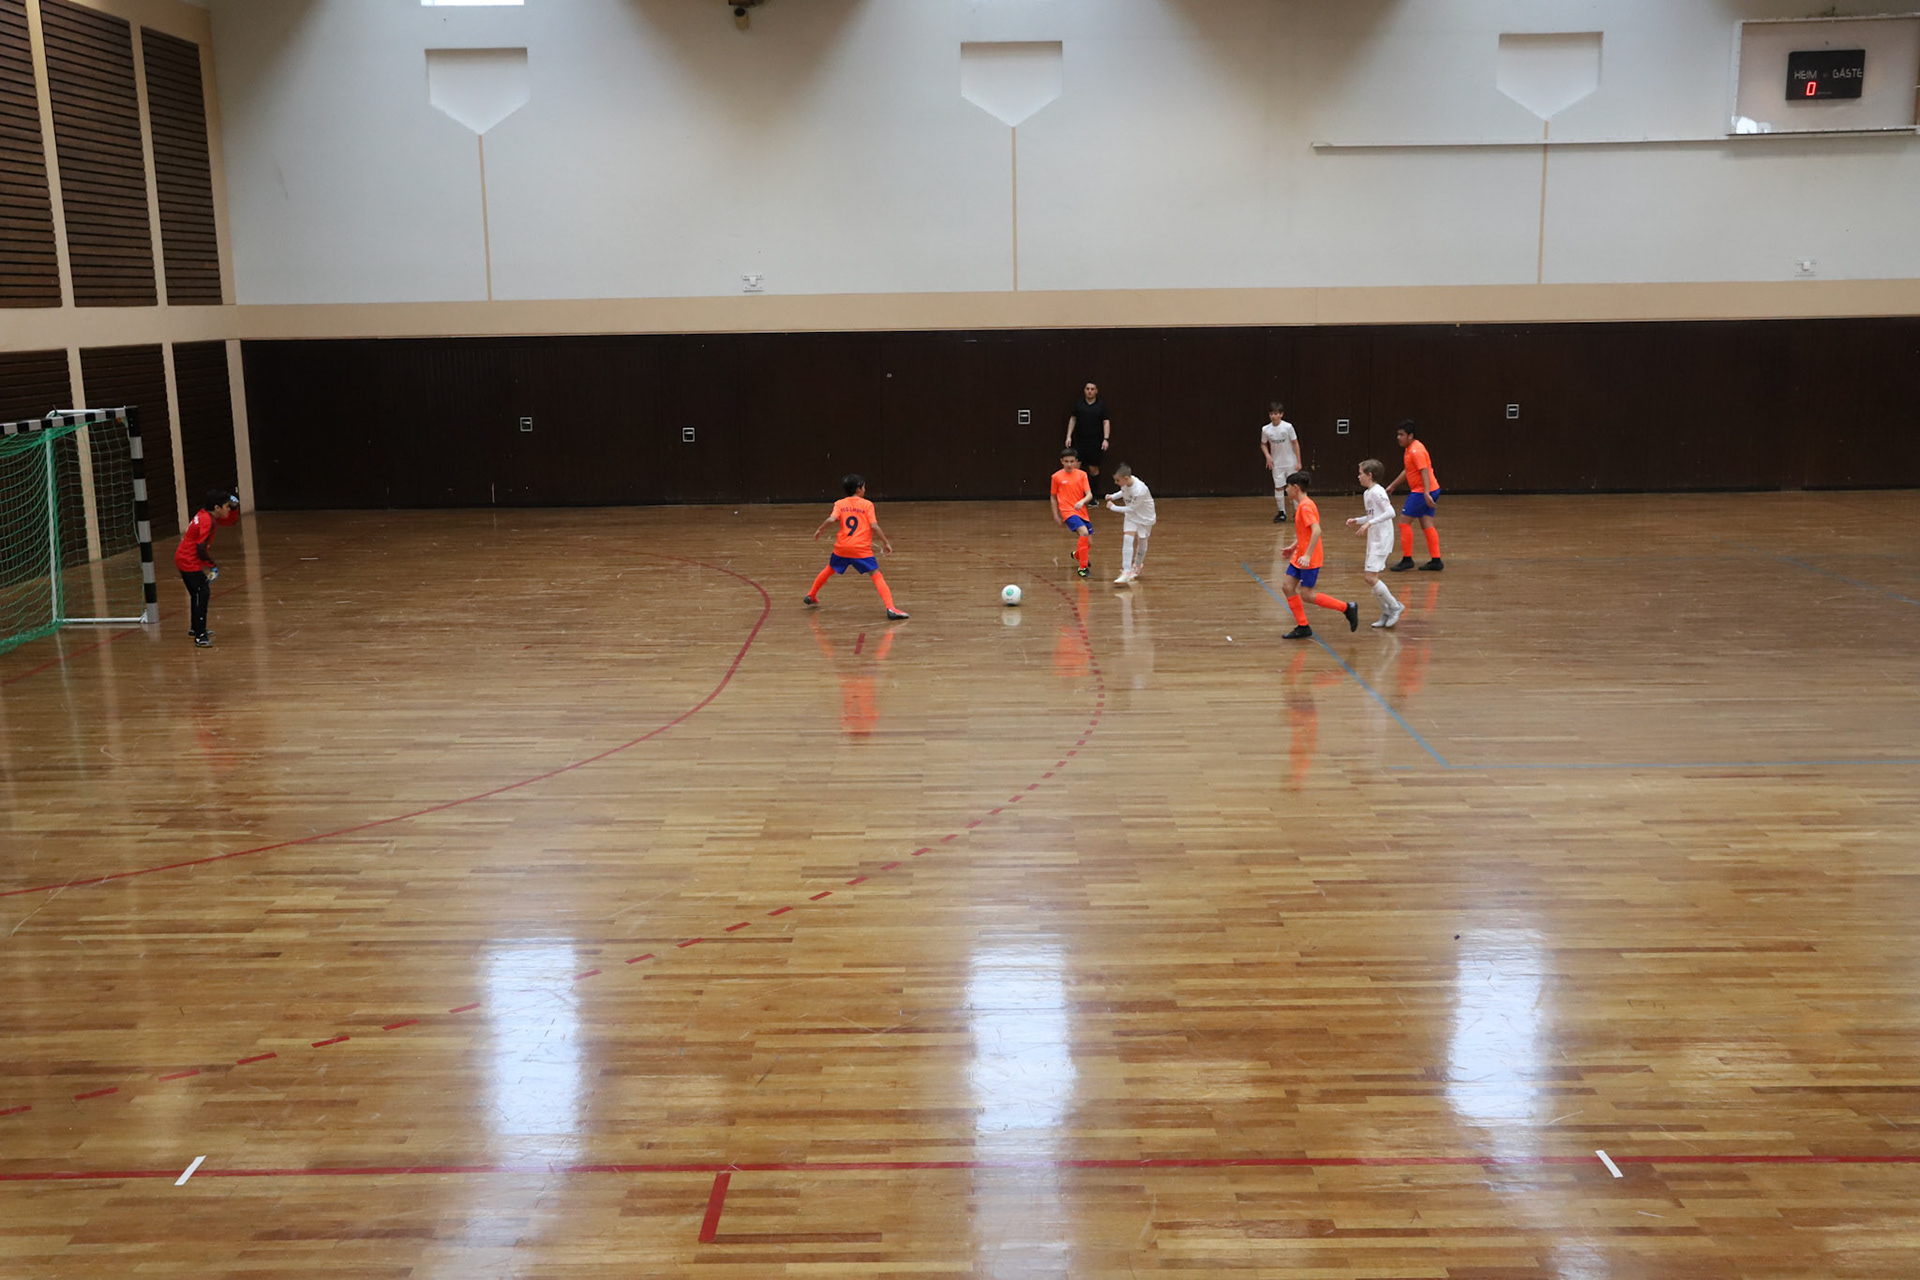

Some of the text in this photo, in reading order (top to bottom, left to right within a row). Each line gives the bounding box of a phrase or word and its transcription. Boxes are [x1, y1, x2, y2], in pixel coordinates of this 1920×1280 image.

[1794, 70, 1818, 80] HEIM
[1805, 81, 1817, 97] 0
[845, 516, 858, 536] 9
